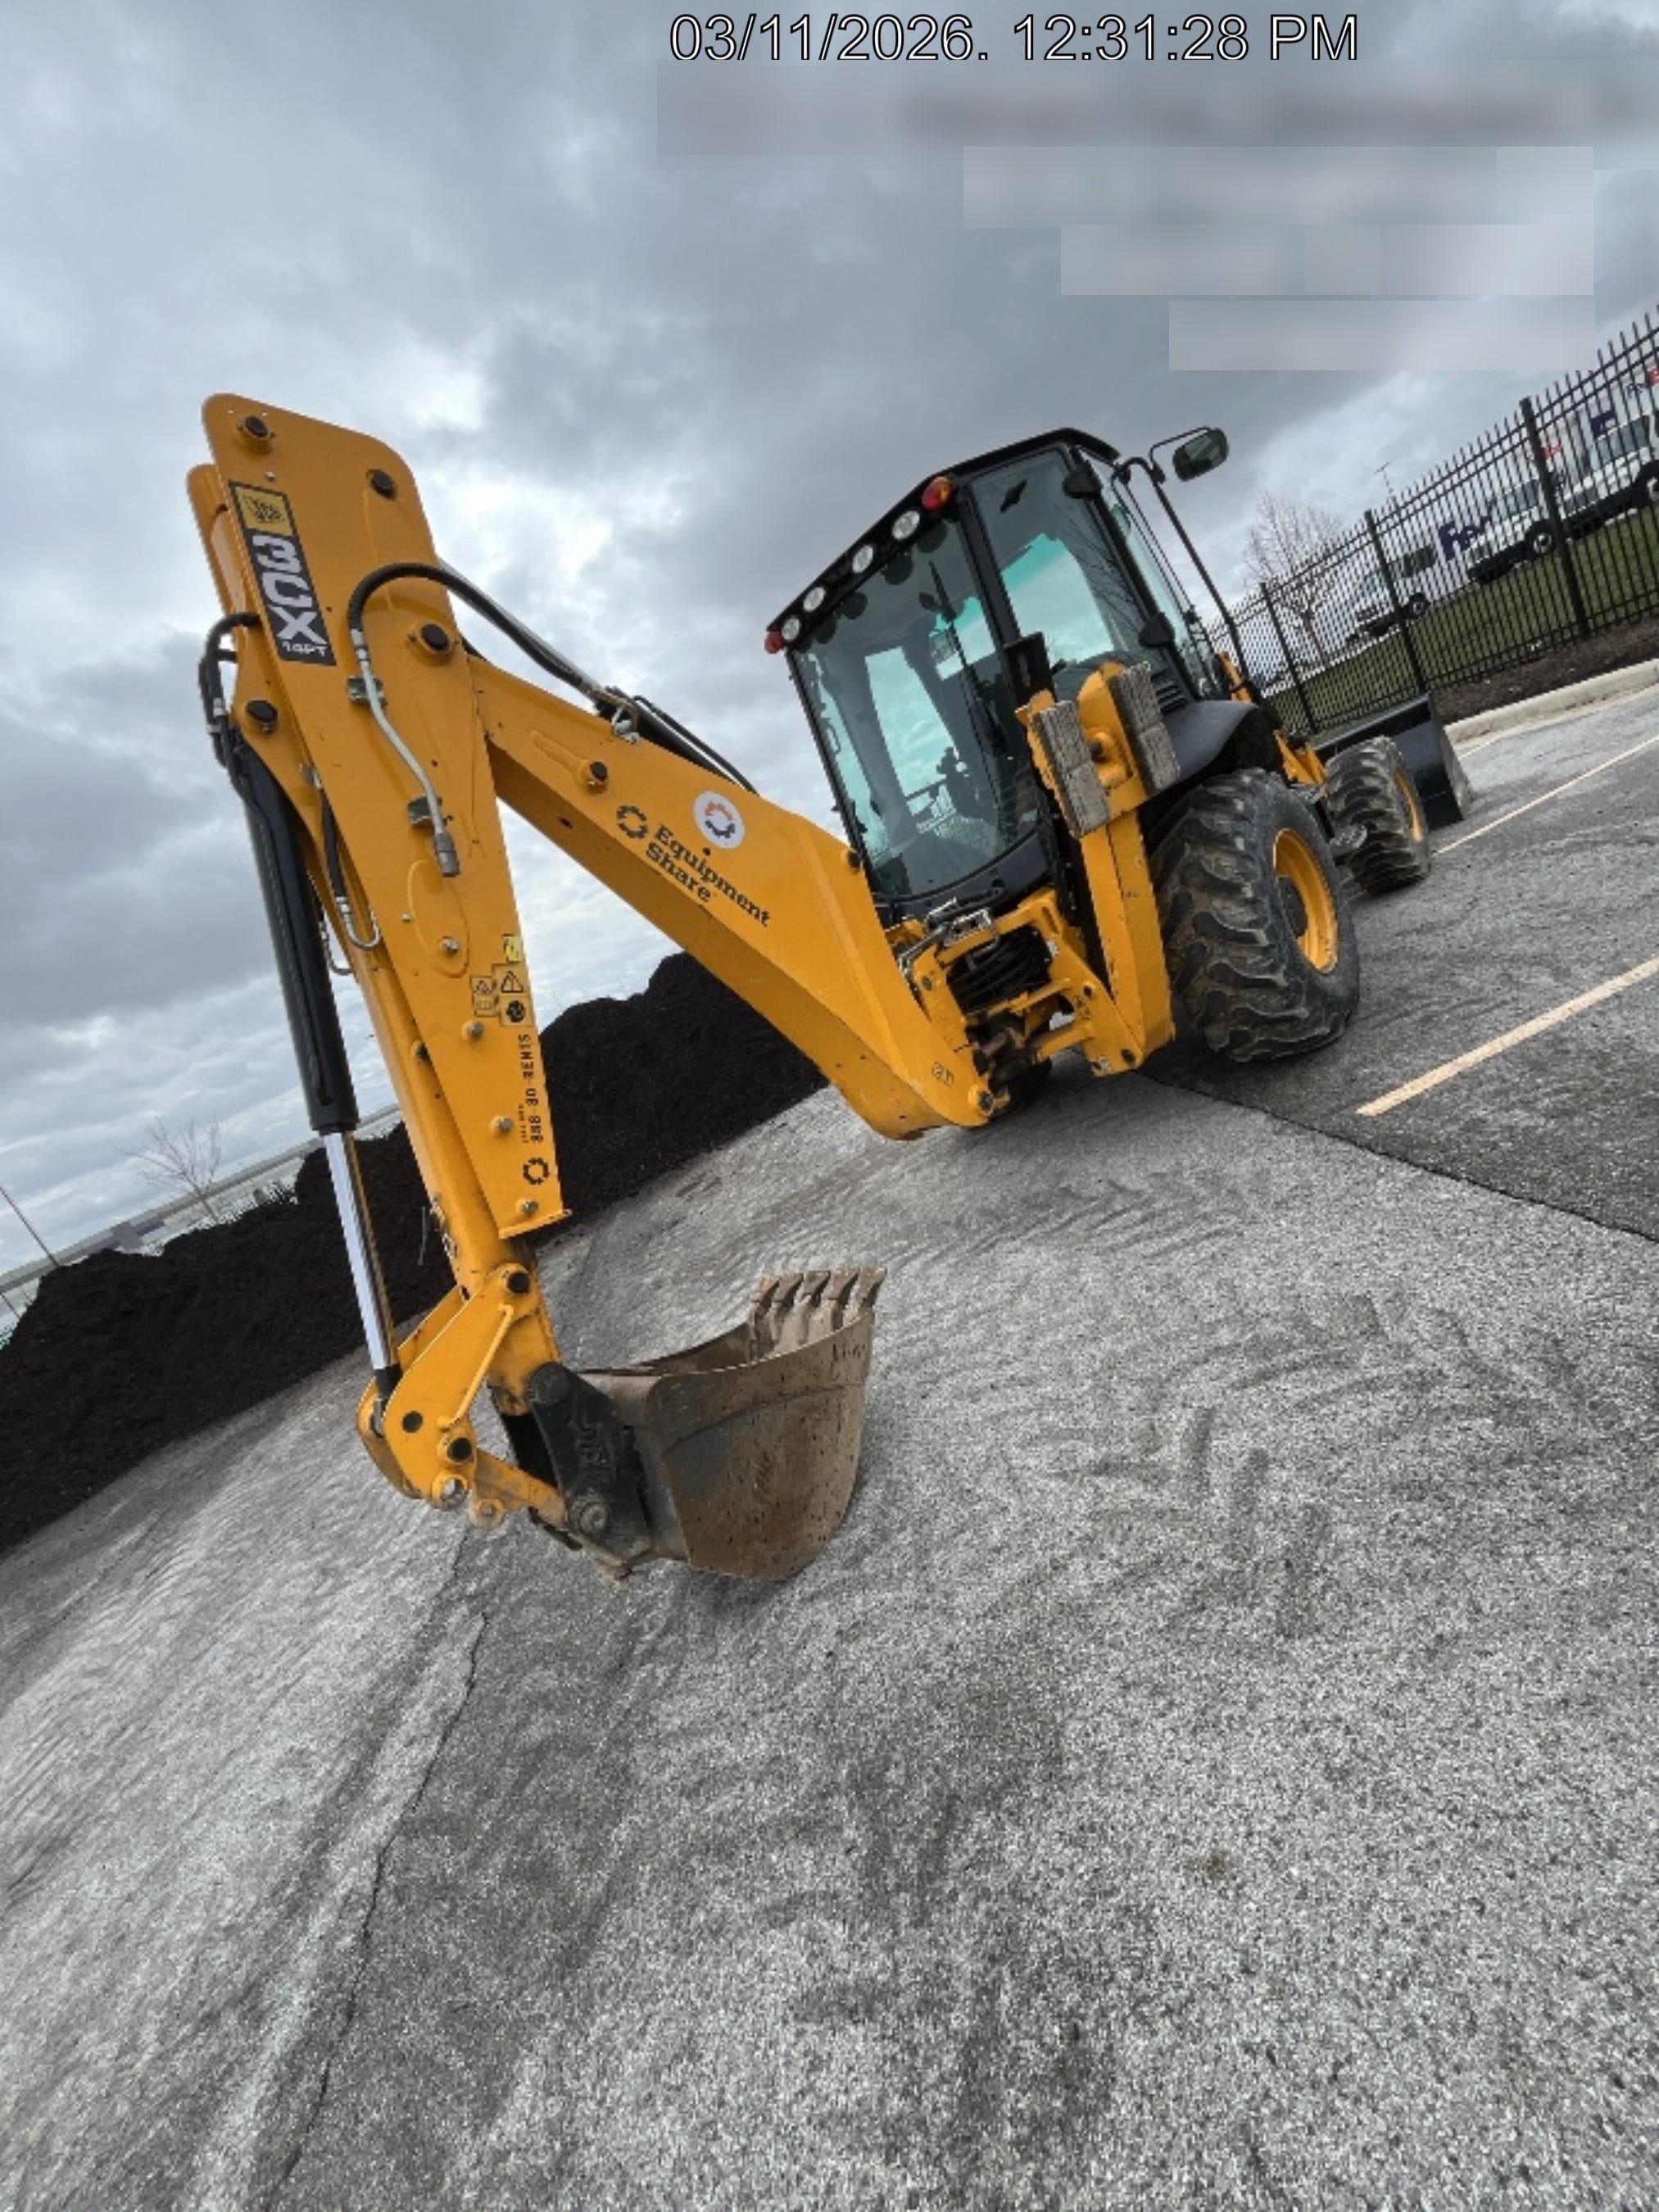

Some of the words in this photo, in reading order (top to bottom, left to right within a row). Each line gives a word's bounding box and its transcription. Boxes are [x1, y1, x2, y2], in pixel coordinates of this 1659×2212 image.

[252, 535, 328, 645] 3CX
[645, 842, 713, 903] Share
[654, 823, 772, 927] Equipment
